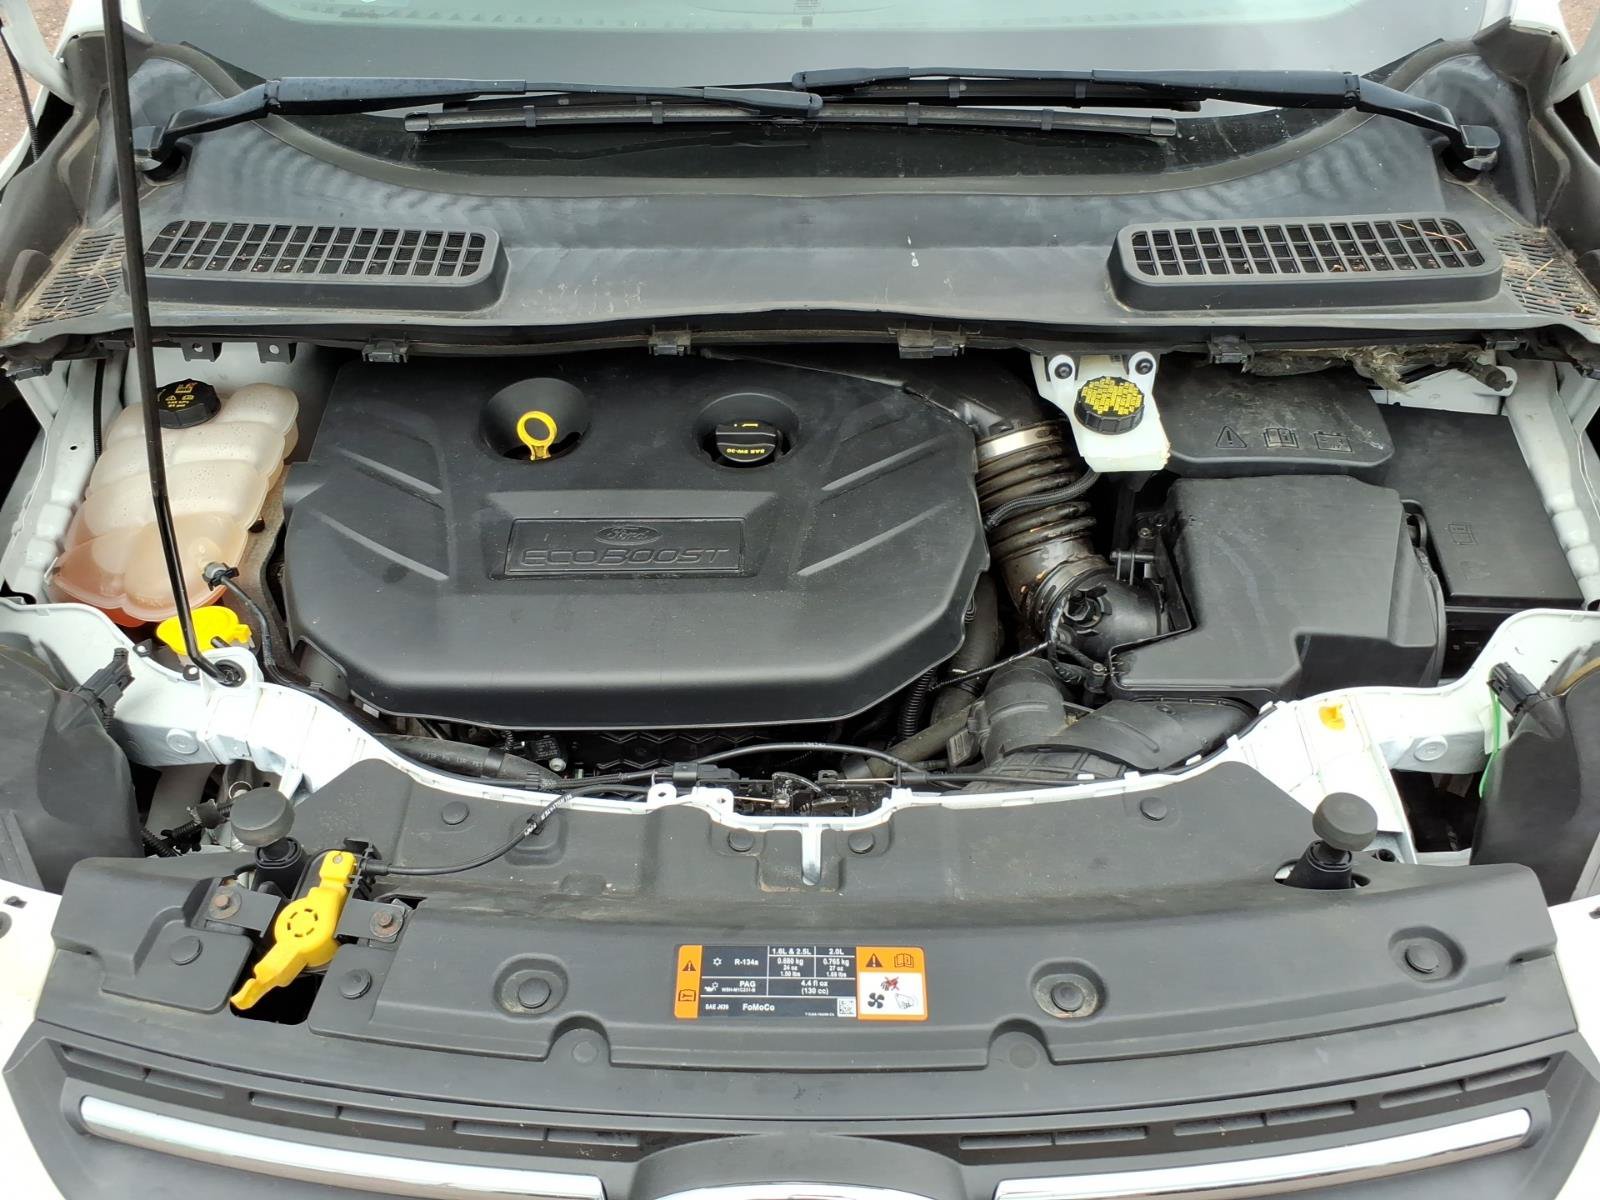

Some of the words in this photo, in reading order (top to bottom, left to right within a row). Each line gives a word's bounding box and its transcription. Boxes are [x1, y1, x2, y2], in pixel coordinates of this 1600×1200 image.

[607, 527, 652, 542] Ford
[521, 549, 730, 566] ECOBOOST
[772, 947, 787, 955] 1.6L
[734, 958, 759, 966] R-134a
[795, 957, 804, 966] kg
[841, 958, 850, 967] kg
[739, 980, 756, 988] PAG
[801, 987, 817, 995] (130
[742, 1003, 775, 1011] FoMoCo
